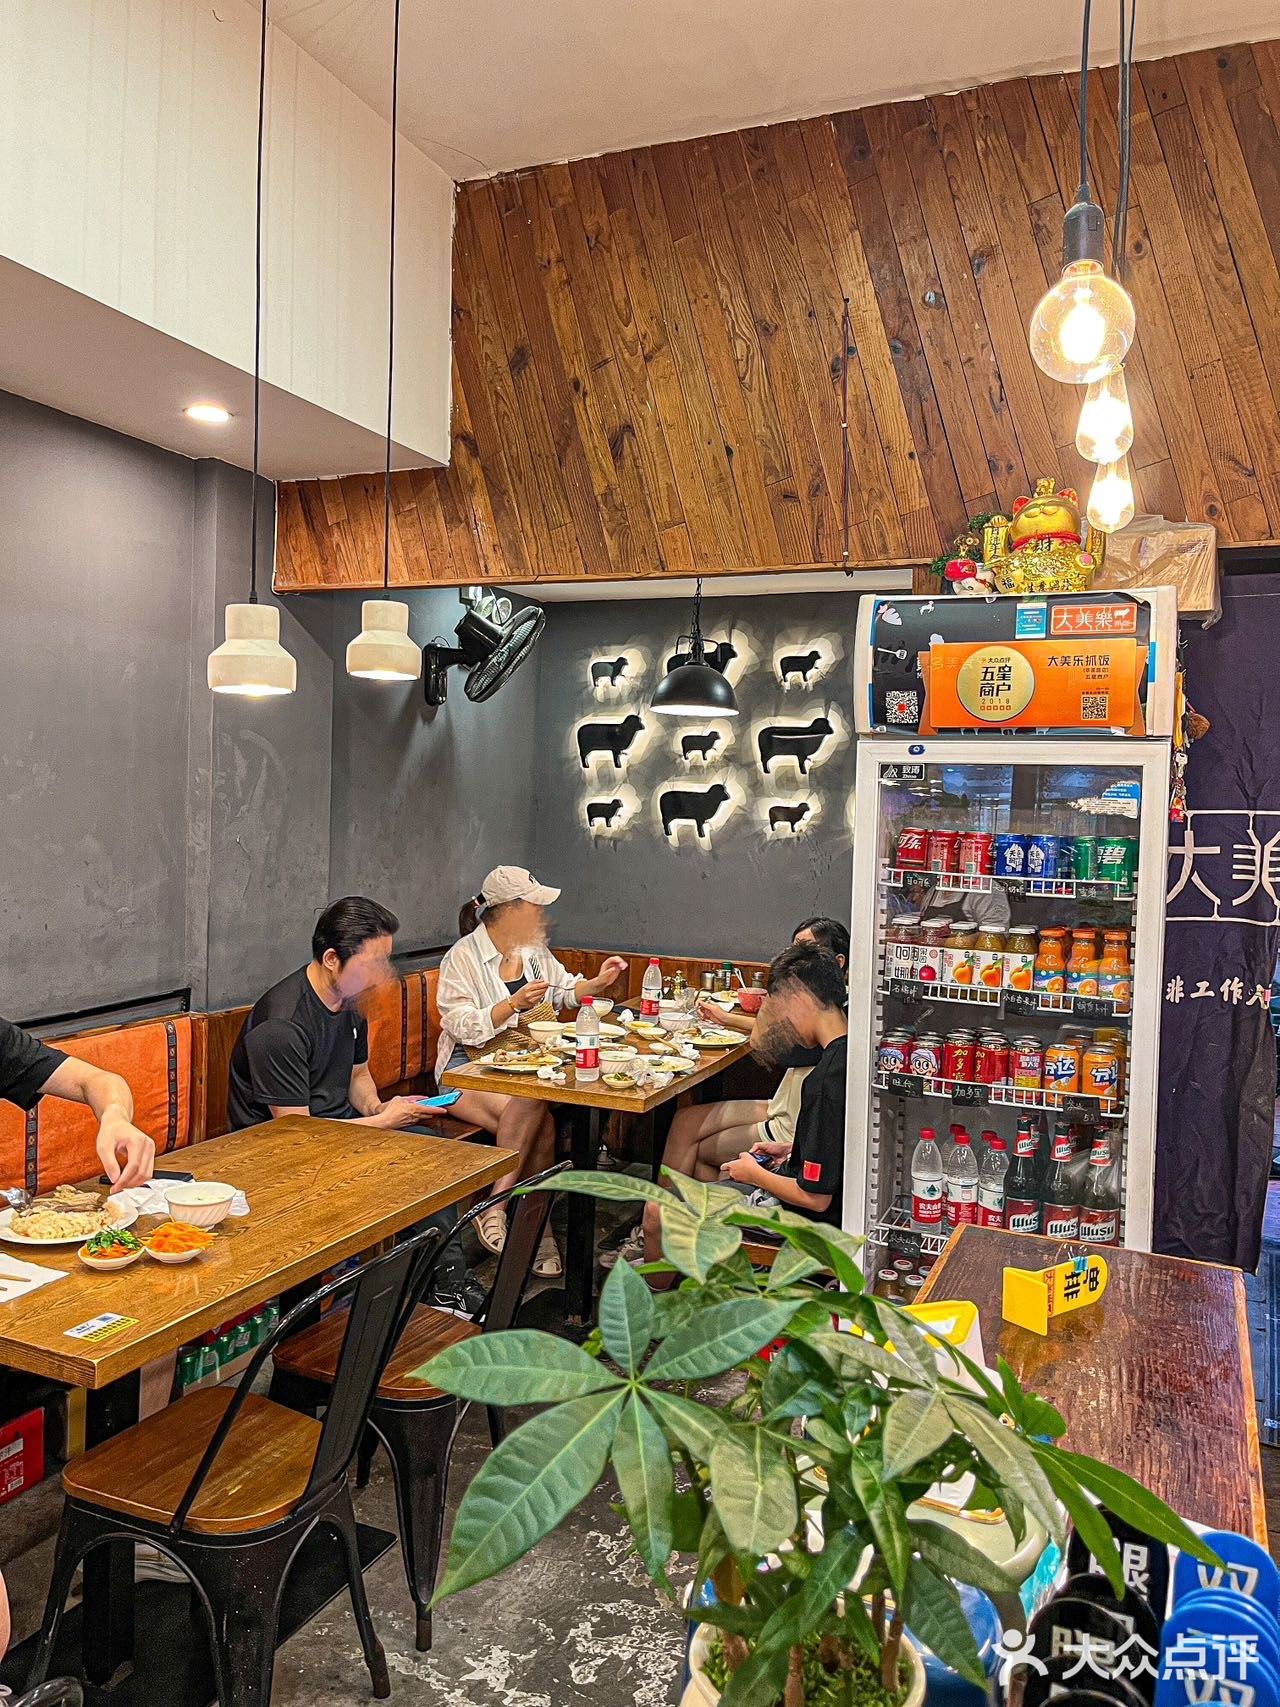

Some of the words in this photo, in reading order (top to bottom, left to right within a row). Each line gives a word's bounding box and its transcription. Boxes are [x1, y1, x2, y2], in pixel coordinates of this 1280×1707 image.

[1001, 577, 1015, 590] 福
[1047, 654, 1110, 667] 大美乐抓饭
[981, 664, 1013, 681] 五星
[980, 682, 1012, 697] 商户
